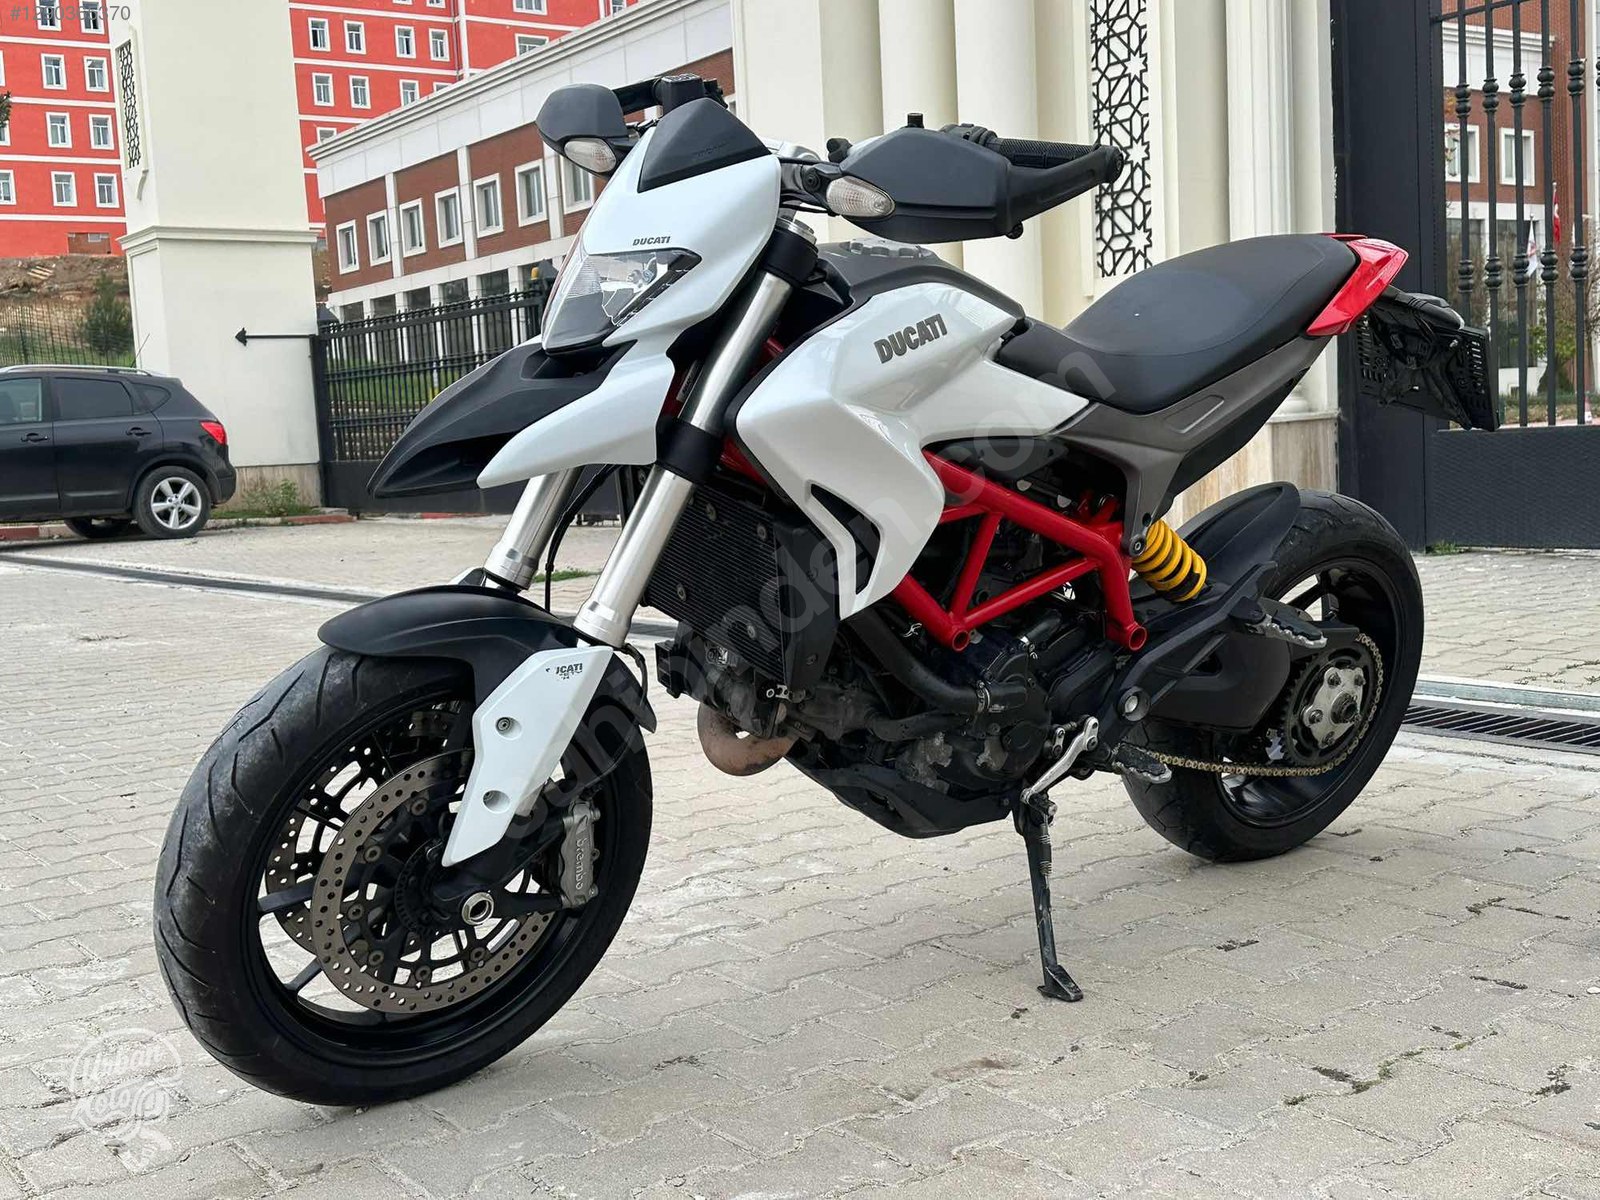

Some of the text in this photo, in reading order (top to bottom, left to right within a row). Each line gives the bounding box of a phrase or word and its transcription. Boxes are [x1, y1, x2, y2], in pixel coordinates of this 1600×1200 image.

[632, 235, 671, 246] DUCATI
[873, 313, 948, 364] DUCATI
[575, 838, 588, 890] brembo
